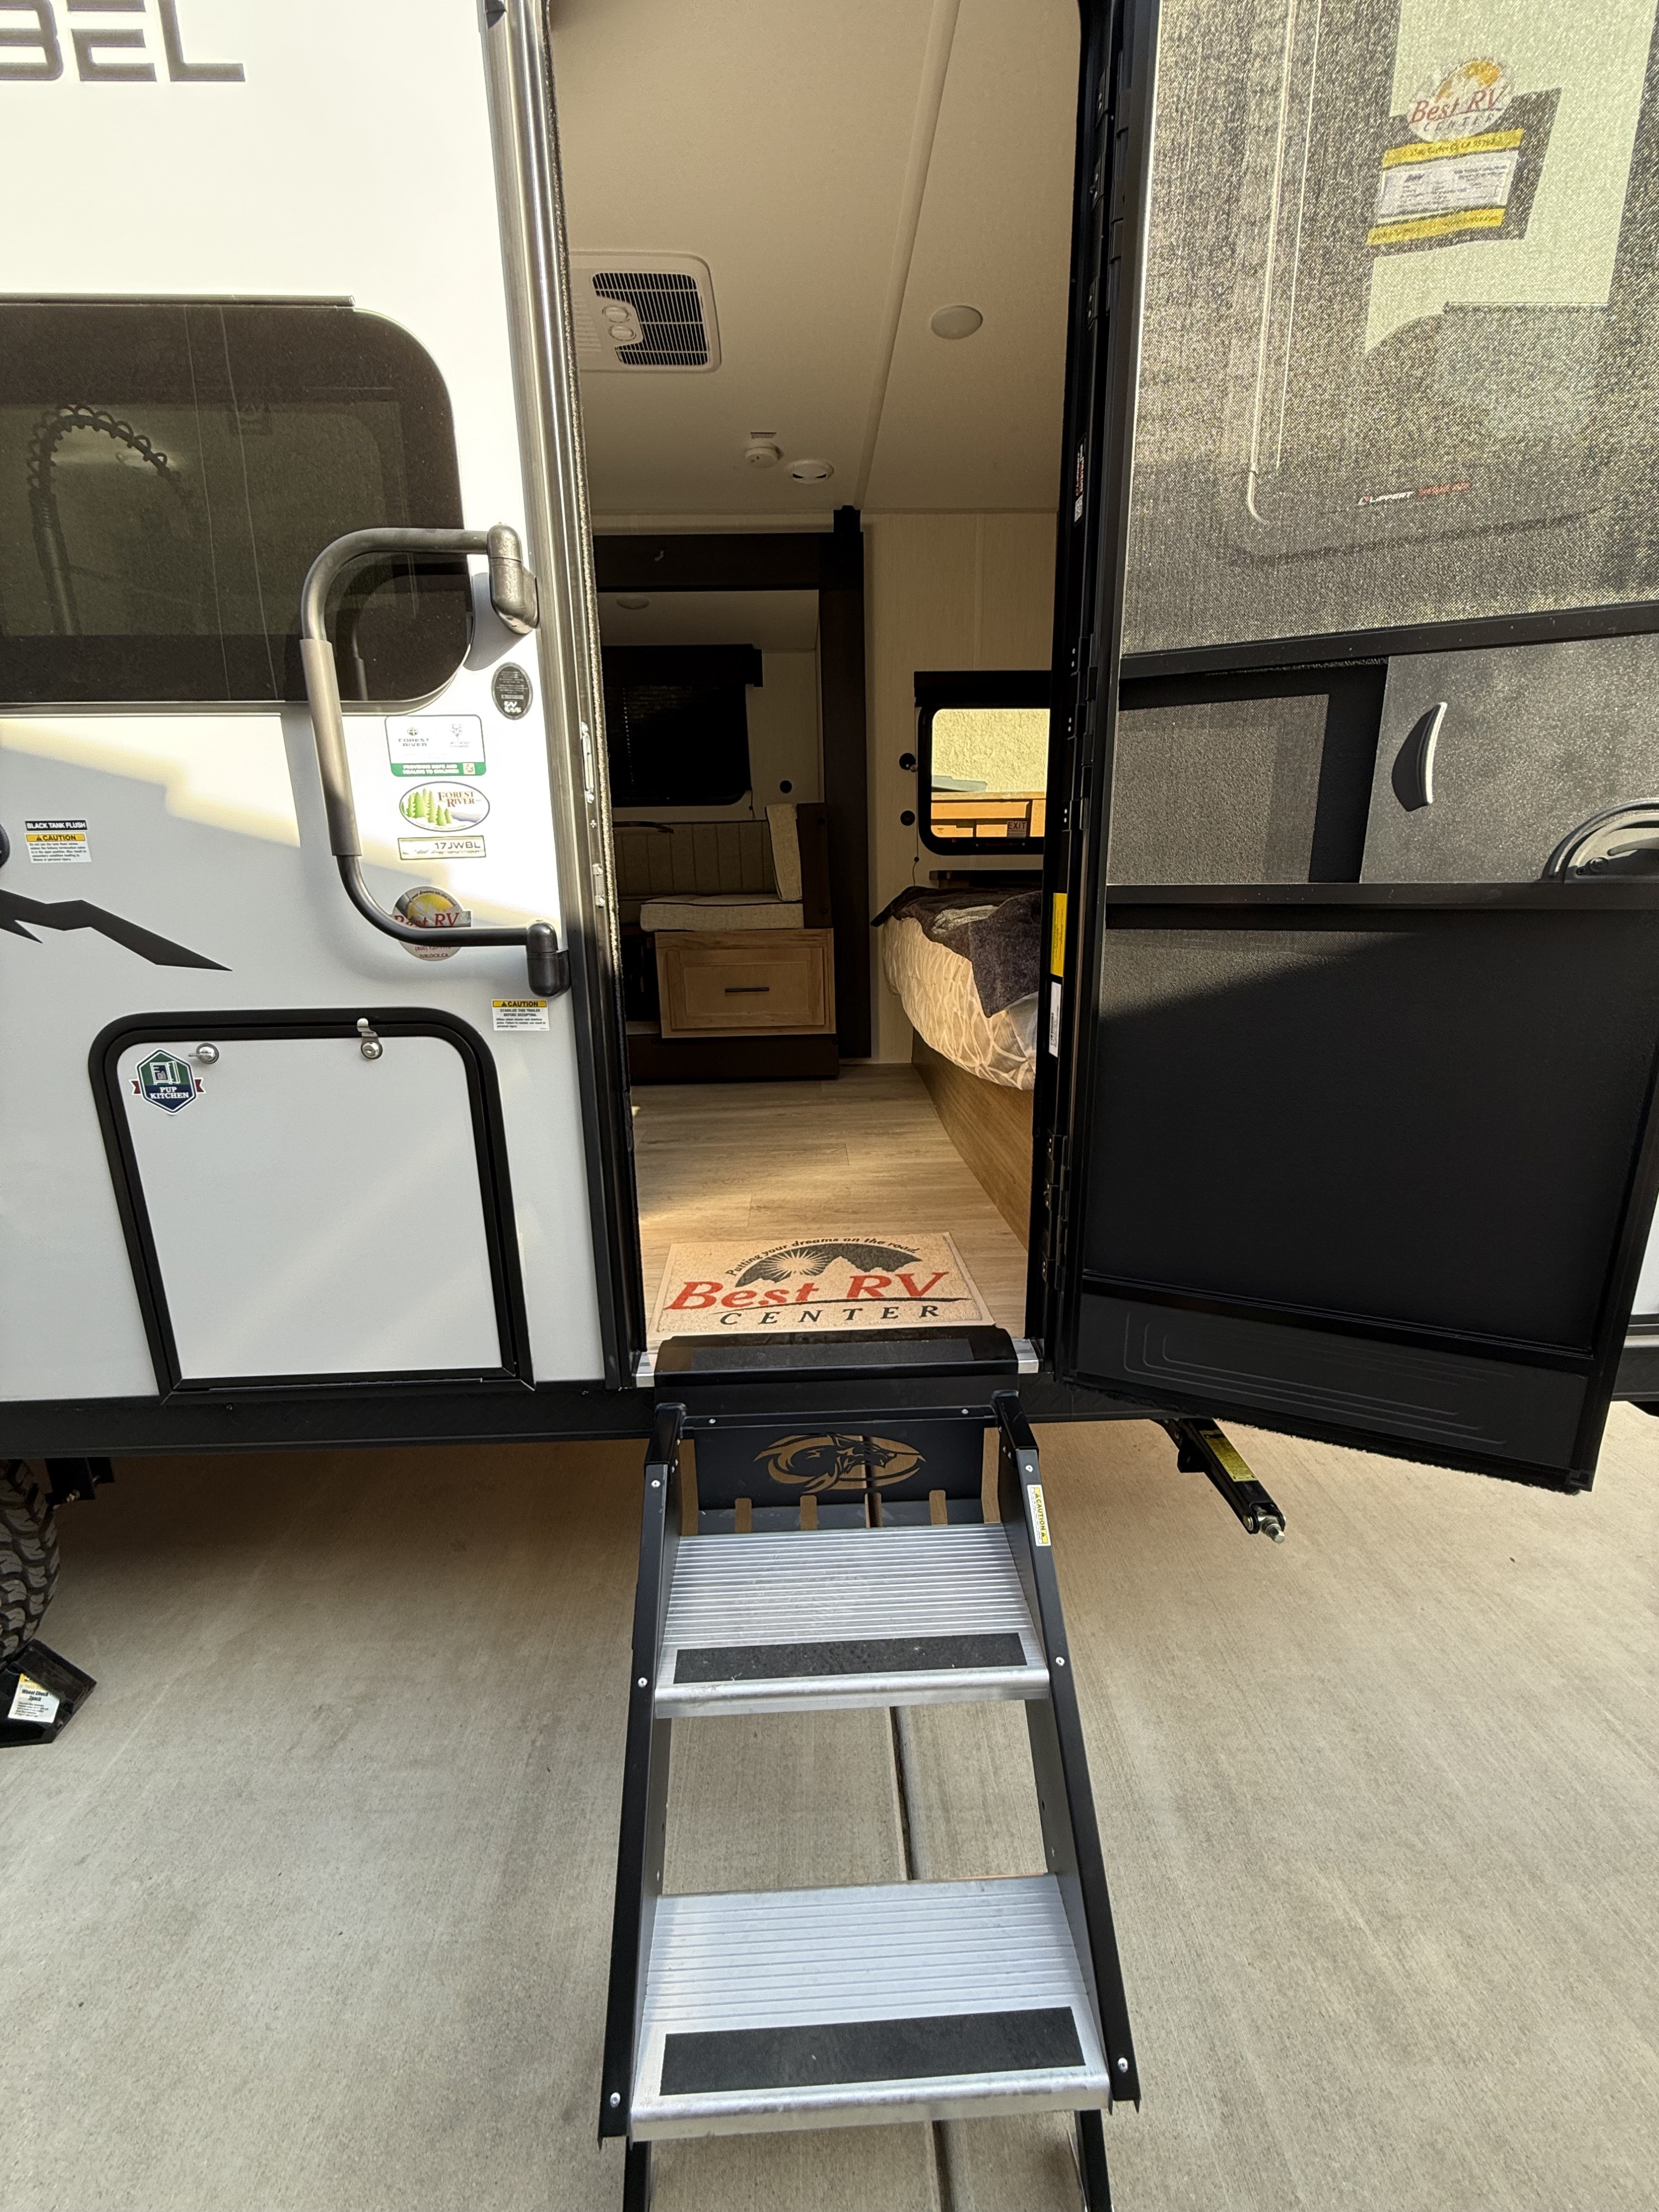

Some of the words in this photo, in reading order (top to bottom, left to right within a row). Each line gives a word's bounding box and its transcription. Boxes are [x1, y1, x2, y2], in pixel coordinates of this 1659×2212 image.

[1410, 97, 1459, 124] Best
[1467, 84, 1510, 112] RV
[1423, 114, 1494, 133] CENTER
[438, 791, 474, 801] FOREST
[447, 798, 474, 807] RIVER
[435, 912, 460, 926] RV
[725, 1254, 763, 1276] Putting
[761, 1244, 787, 1257] your
[792, 1238, 839, 1248] dreams
[664, 1280, 819, 1310] Best
[846, 1272, 950, 1299] RV
[720, 1305, 940, 1326] CENTER
[1036, 1499, 1045, 1531] CAUTION
